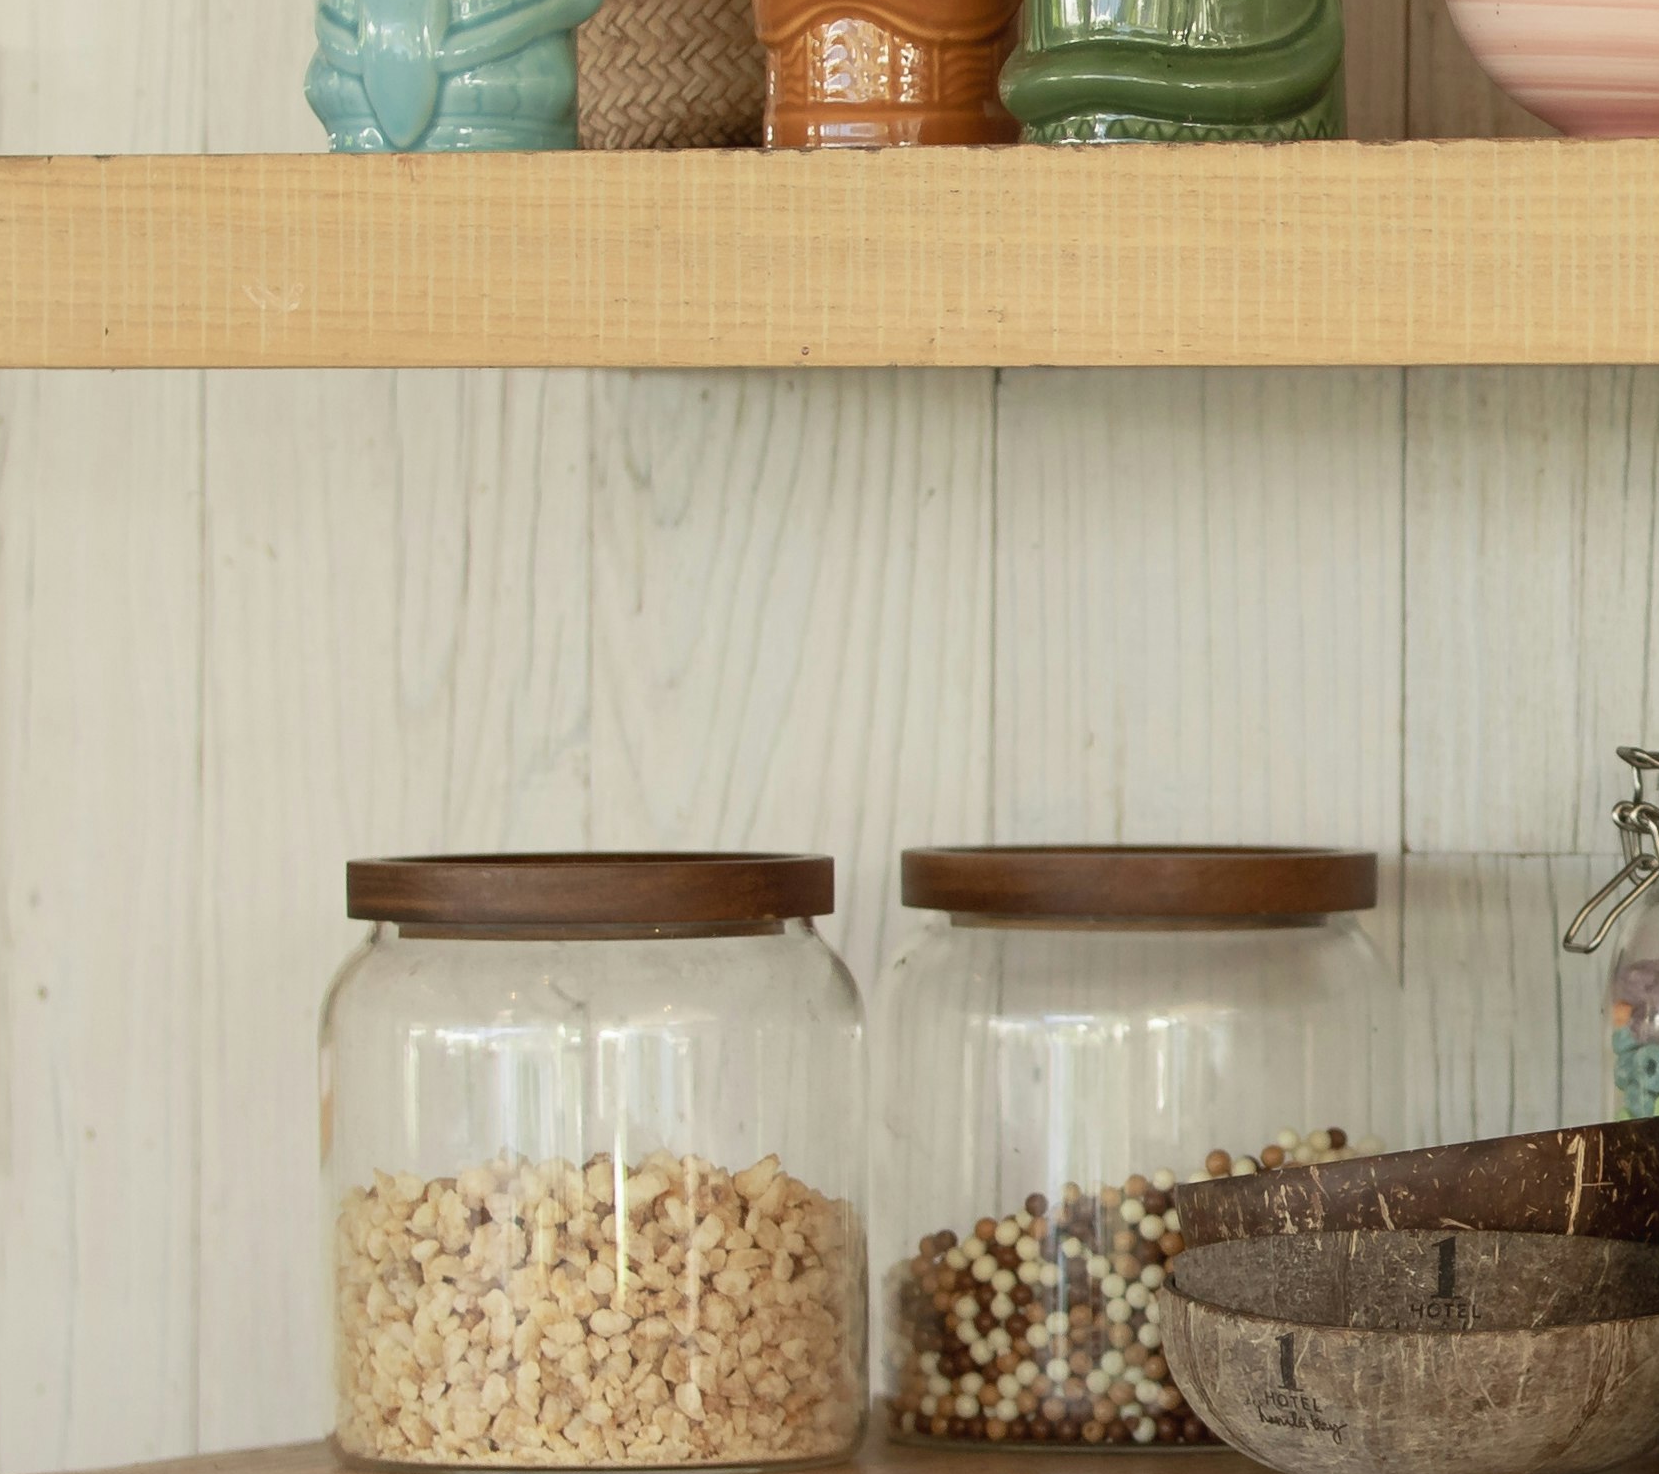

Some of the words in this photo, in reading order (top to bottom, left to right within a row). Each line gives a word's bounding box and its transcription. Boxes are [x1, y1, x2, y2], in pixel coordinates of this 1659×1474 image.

[1430, 1235, 1463, 1300] 1
[1410, 1302, 1482, 1320] HOTEL
[1274, 1331, 1304, 1393] 1
[1264, 1390, 1324, 1414] HOTEL
